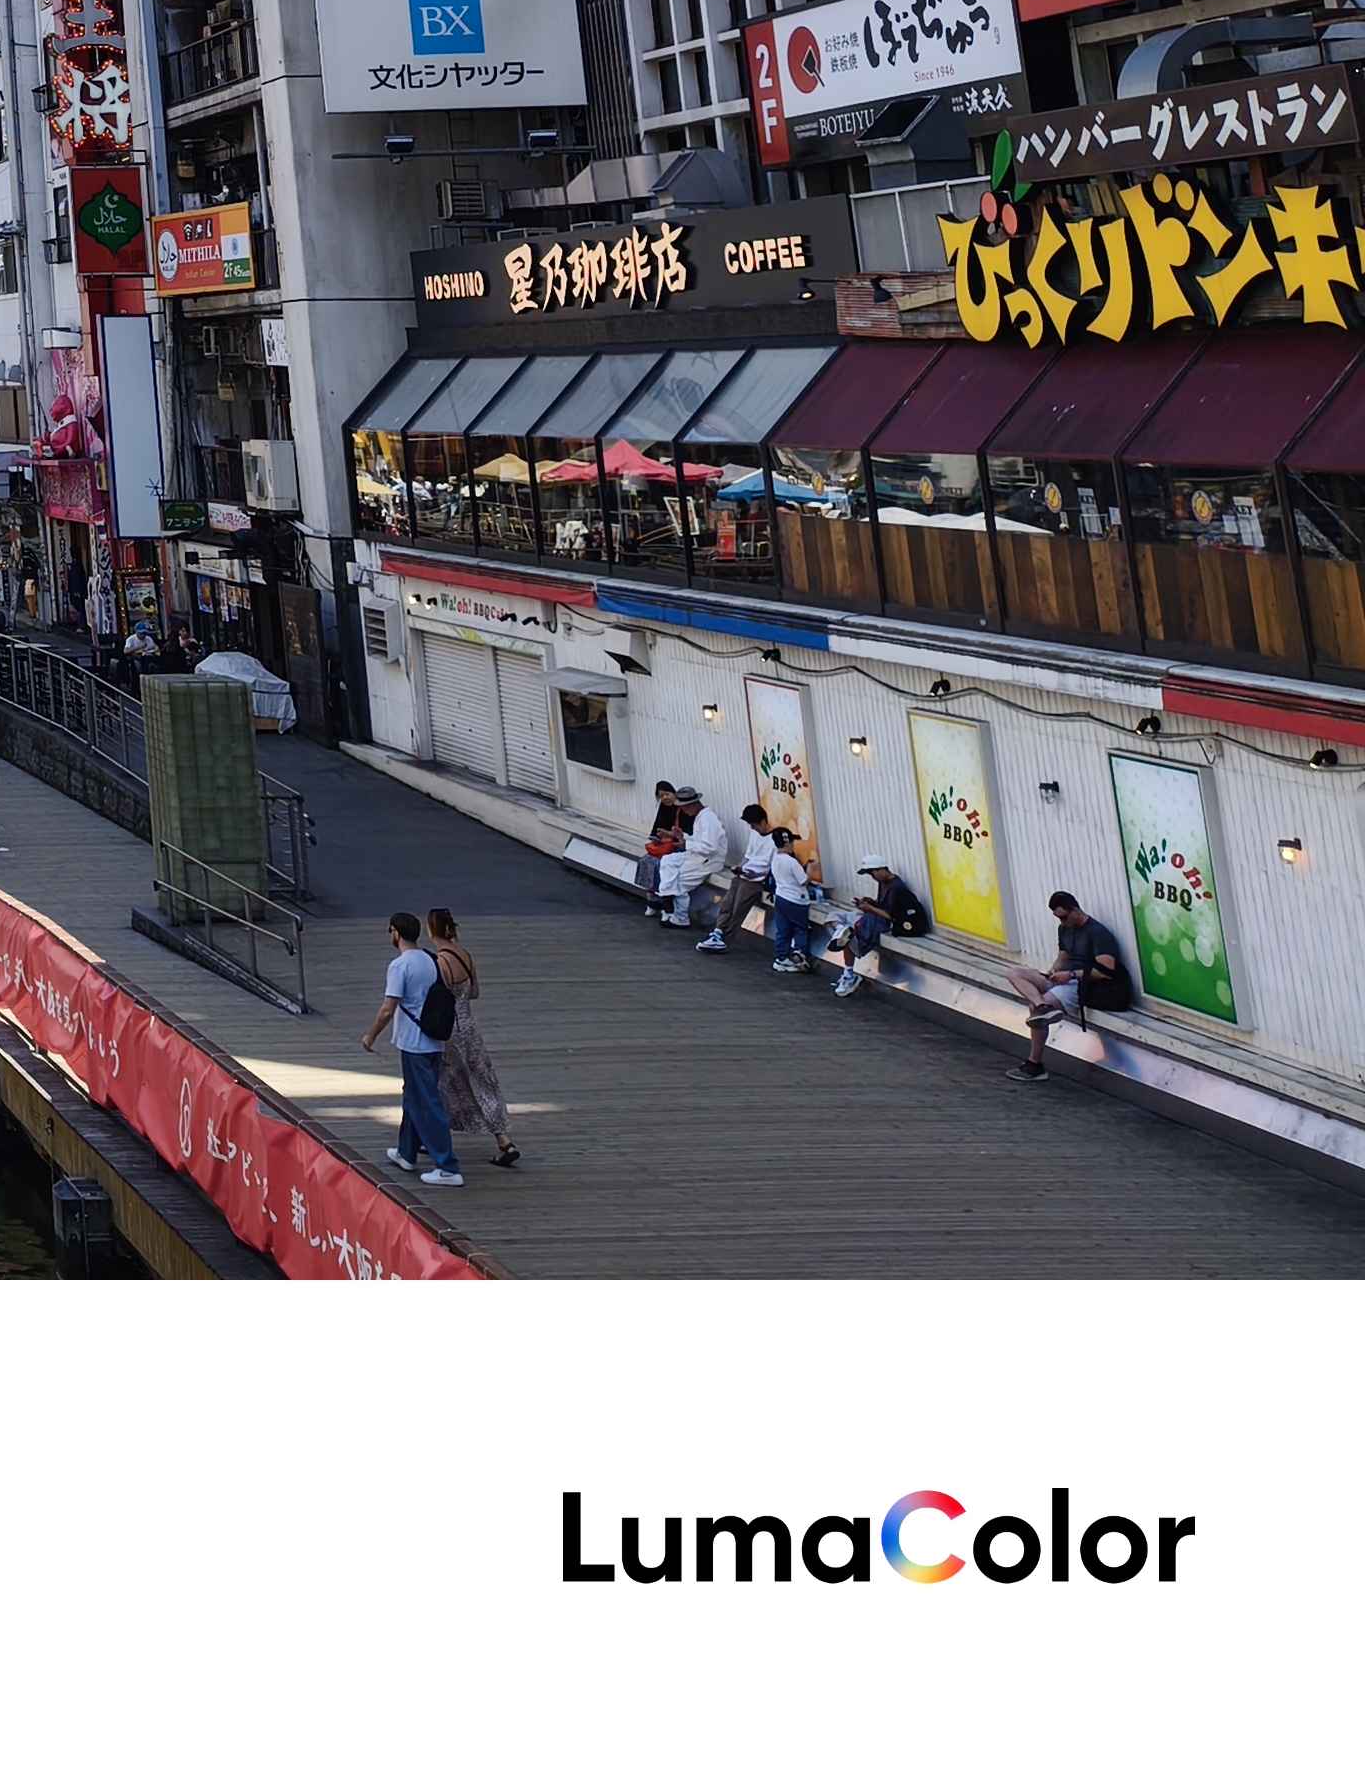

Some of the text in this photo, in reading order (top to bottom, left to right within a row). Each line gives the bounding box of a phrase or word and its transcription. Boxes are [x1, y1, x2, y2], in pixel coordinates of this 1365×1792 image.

[419, 5, 474, 38] BX
[825, 32, 859, 53] お好み焼
[830, 55, 858, 74] 鉄板焼
[914, 64, 955, 82] Since 1946
[756, 44, 777, 143] 2F
[820, 109, 875, 137] BOTEJYU
[1016, 81, 1348, 168] ハンバーグレストラン
[94, 207, 127, 225] حلال
[98, 226, 127, 234] HALAL
[178, 244, 223, 264] MITHILA
[504, 222, 688, 313] 星乃珈琲店
[724, 235, 805, 275] COFFEE
[938, 173, 1365, 349] びっくりドンキ
[224, 262, 233, 279] 2F
[424, 270, 484, 300] HOSHINO
[474, 602, 490, 620] BBQ
[772, 775, 798, 799] BBQ
[943, 822, 974, 850] BBQ
[1153, 880, 1193, 912] BBQ
